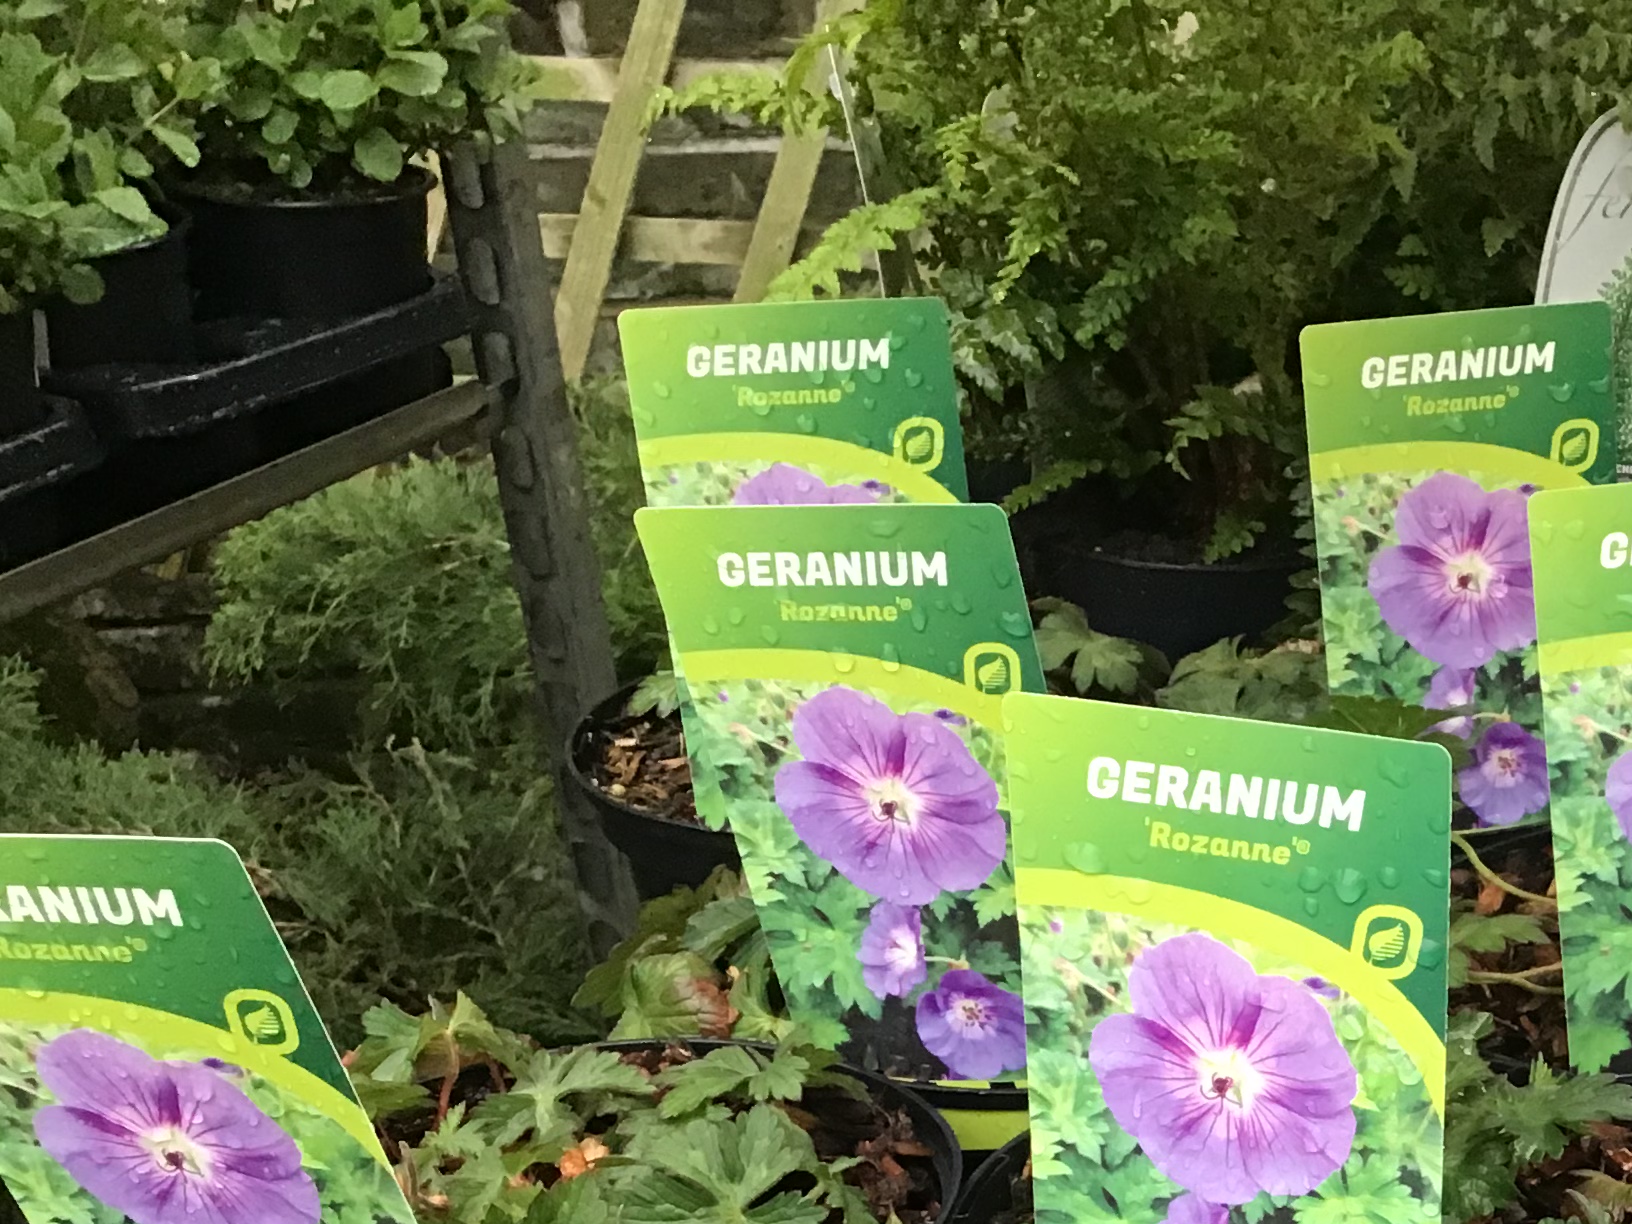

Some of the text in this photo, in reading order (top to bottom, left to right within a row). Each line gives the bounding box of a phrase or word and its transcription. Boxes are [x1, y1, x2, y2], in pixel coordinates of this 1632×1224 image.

[687, 338, 890, 377] GERANIUM
[1361, 341, 1556, 389] GERANIUM
[717, 551, 948, 587] GERANIUM
[1087, 757, 1366, 832] GERANIUM
[0, 885, 184, 926] ANIUM
